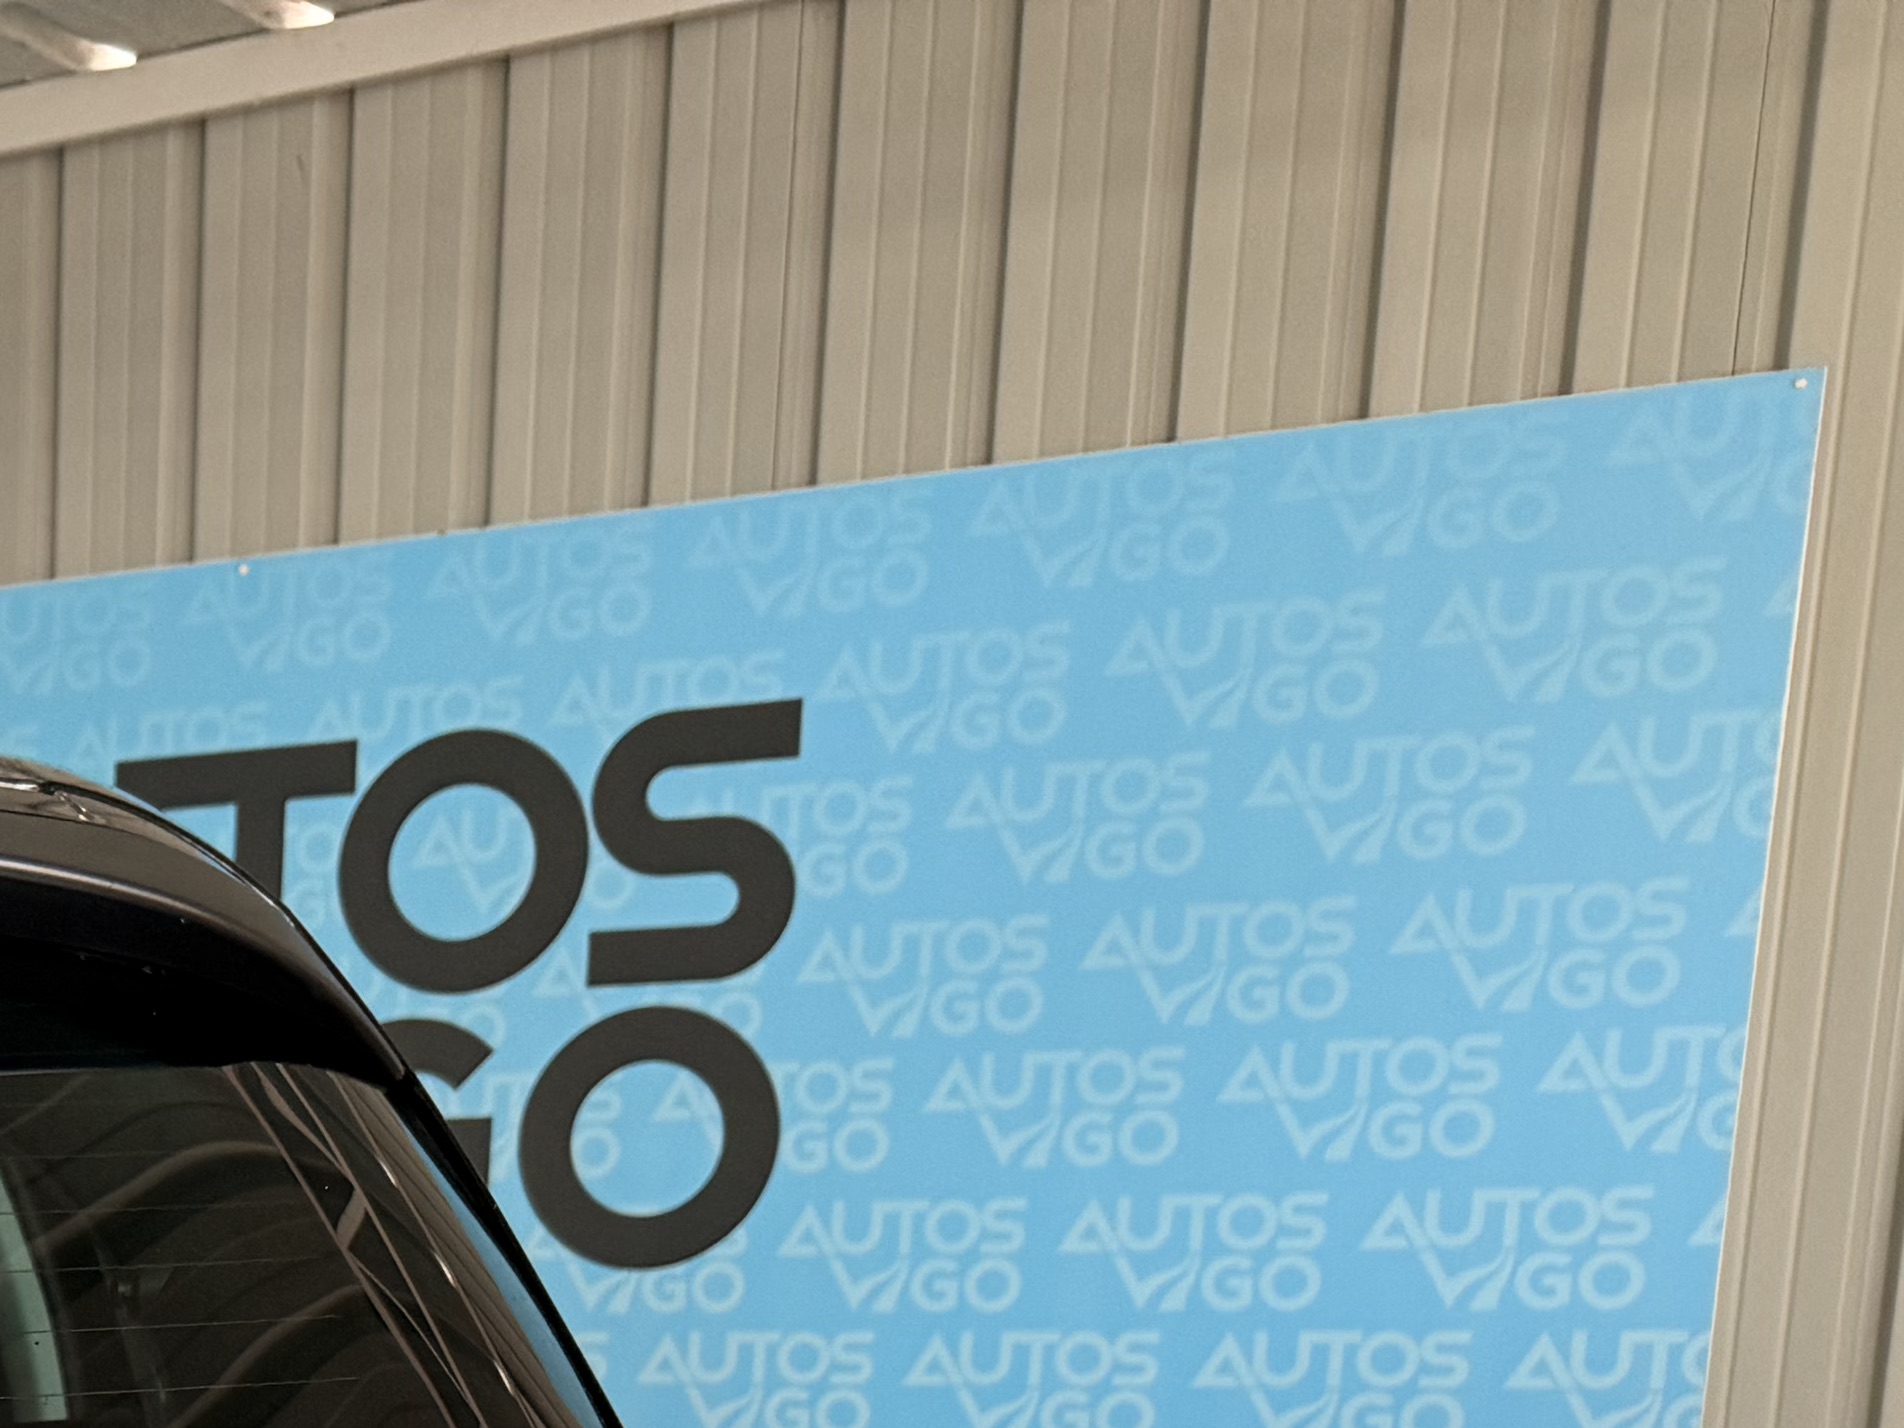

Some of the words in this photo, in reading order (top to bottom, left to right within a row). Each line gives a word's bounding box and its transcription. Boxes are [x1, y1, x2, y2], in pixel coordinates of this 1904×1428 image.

[1274, 406, 1567, 501] AUTOS
[688, 485, 933, 570] AUTOS
[968, 452, 1235, 537] AUTOS
[1104, 588, 1386, 677] AUTOS
[1420, 554, 1727, 645] AUTOS
[814, 619, 1072, 705] AUTOS
[1157, 659, 1381, 730] VIGO
[1484, 629, 1718, 704] VIGO
[867, 685, 1068, 754] VIGO
[945, 751, 1210, 832] AUTOS
[1245, 725, 1535, 807] AUTOS
[998, 815, 1205, 886] VIGO
[1304, 795, 1528, 866] VIGO
[797, 911, 1051, 984] AUTOS
[1079, 894, 1358, 971] AUTOS
[1388, 874, 1691, 956] AUTOS
[847, 976, 1043, 1038] VIGO
[1133, 959, 1351, 1026] VIGO
[1448, 943, 1682, 1013] VIGO
[922, 1043, 1186, 1114] AUTOS
[1216, 1033, 1504, 1102] AUTOS
[978, 1107, 1179, 1169] VIGO
[1273, 1098, 1497, 1162] VIGO
[777, 1199, 1027, 1257] AUTOS
[1057, 1192, 1329, 1253] AUTOS
[1359, 1184, 1655, 1250] AUTOS
[827, 1258, 1023, 1313] VIGO
[1112, 1254, 1322, 1312] VIGO
[1421, 1251, 1646, 1312] VIGO
[635, 1331, 875, 1384] AUTOS
[901, 1331, 1161, 1387] AUTOS
[1191, 1330, 1473, 1389] AUTOS
